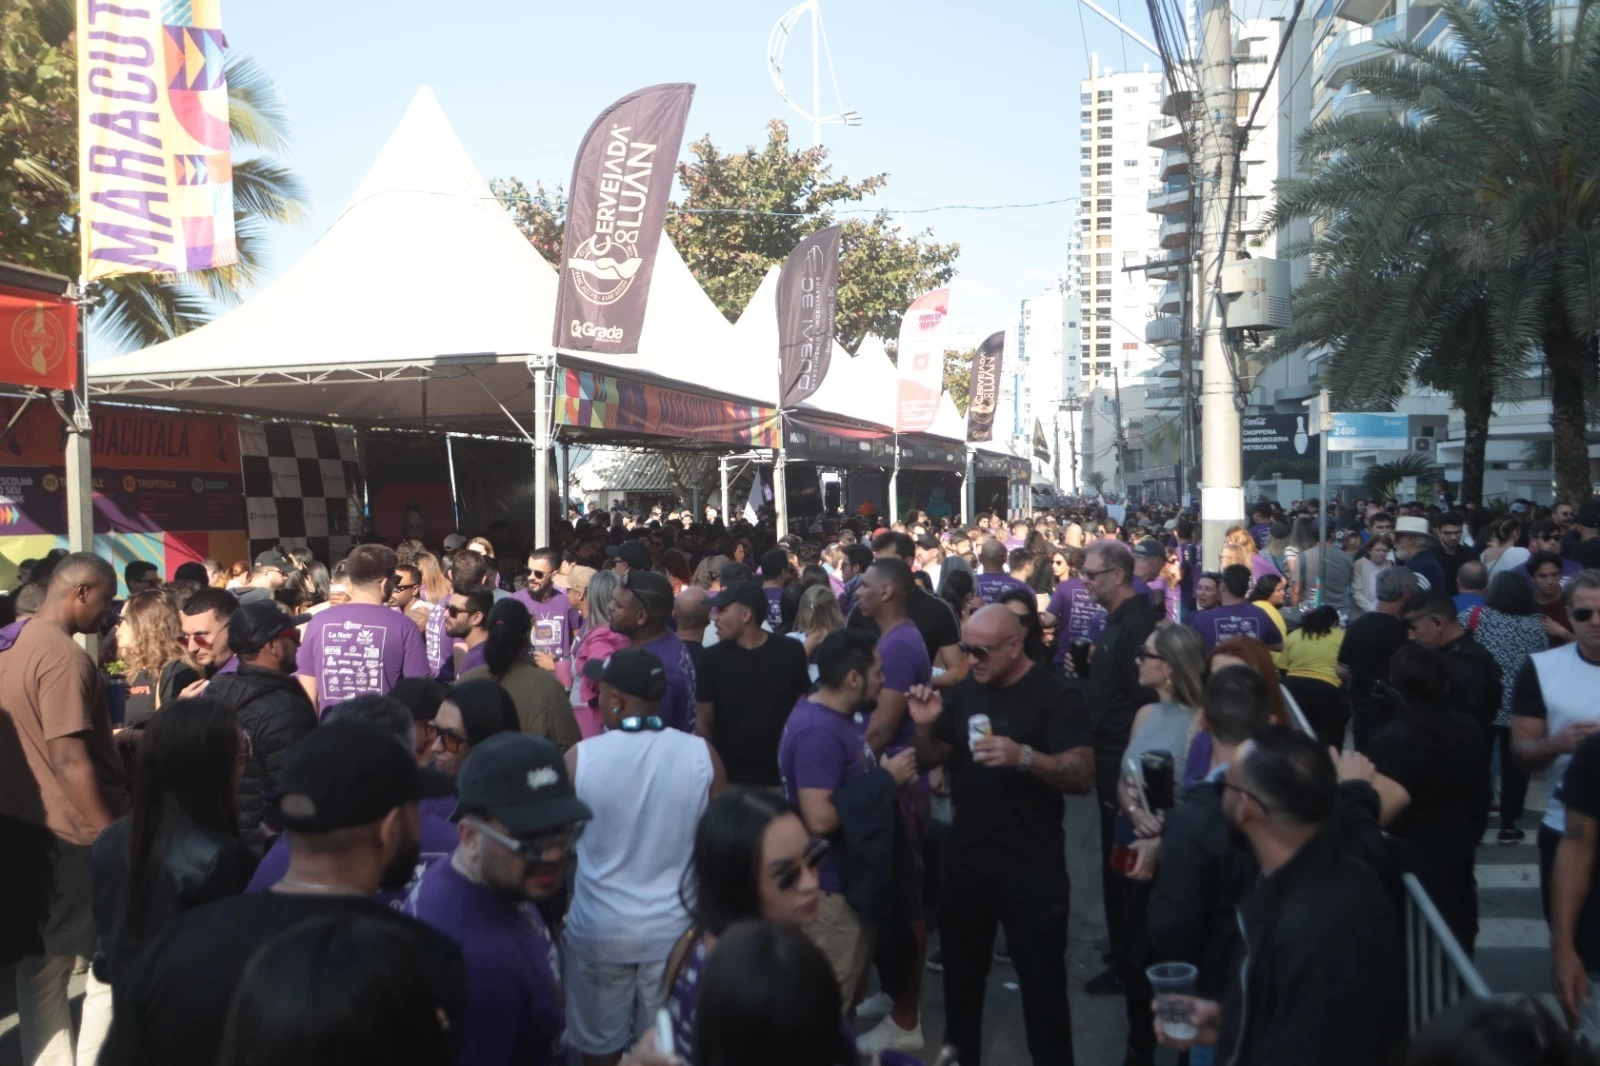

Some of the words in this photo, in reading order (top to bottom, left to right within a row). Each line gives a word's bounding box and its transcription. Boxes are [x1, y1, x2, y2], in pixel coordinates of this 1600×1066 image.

[589, 126, 631, 256] CERVEJADA
[617, 142, 657, 227] LUAN
[802, 277, 813, 308] BC
[582, 322, 624, 340] Grada
[798, 319, 813, 390] DUBAI
[975, 353, 986, 404] CERVEJADA
[1242, 436, 1290, 444] HAMBURGUERIA
[1334, 426, 1357, 436] 2400
[328, 631, 337, 639] La
